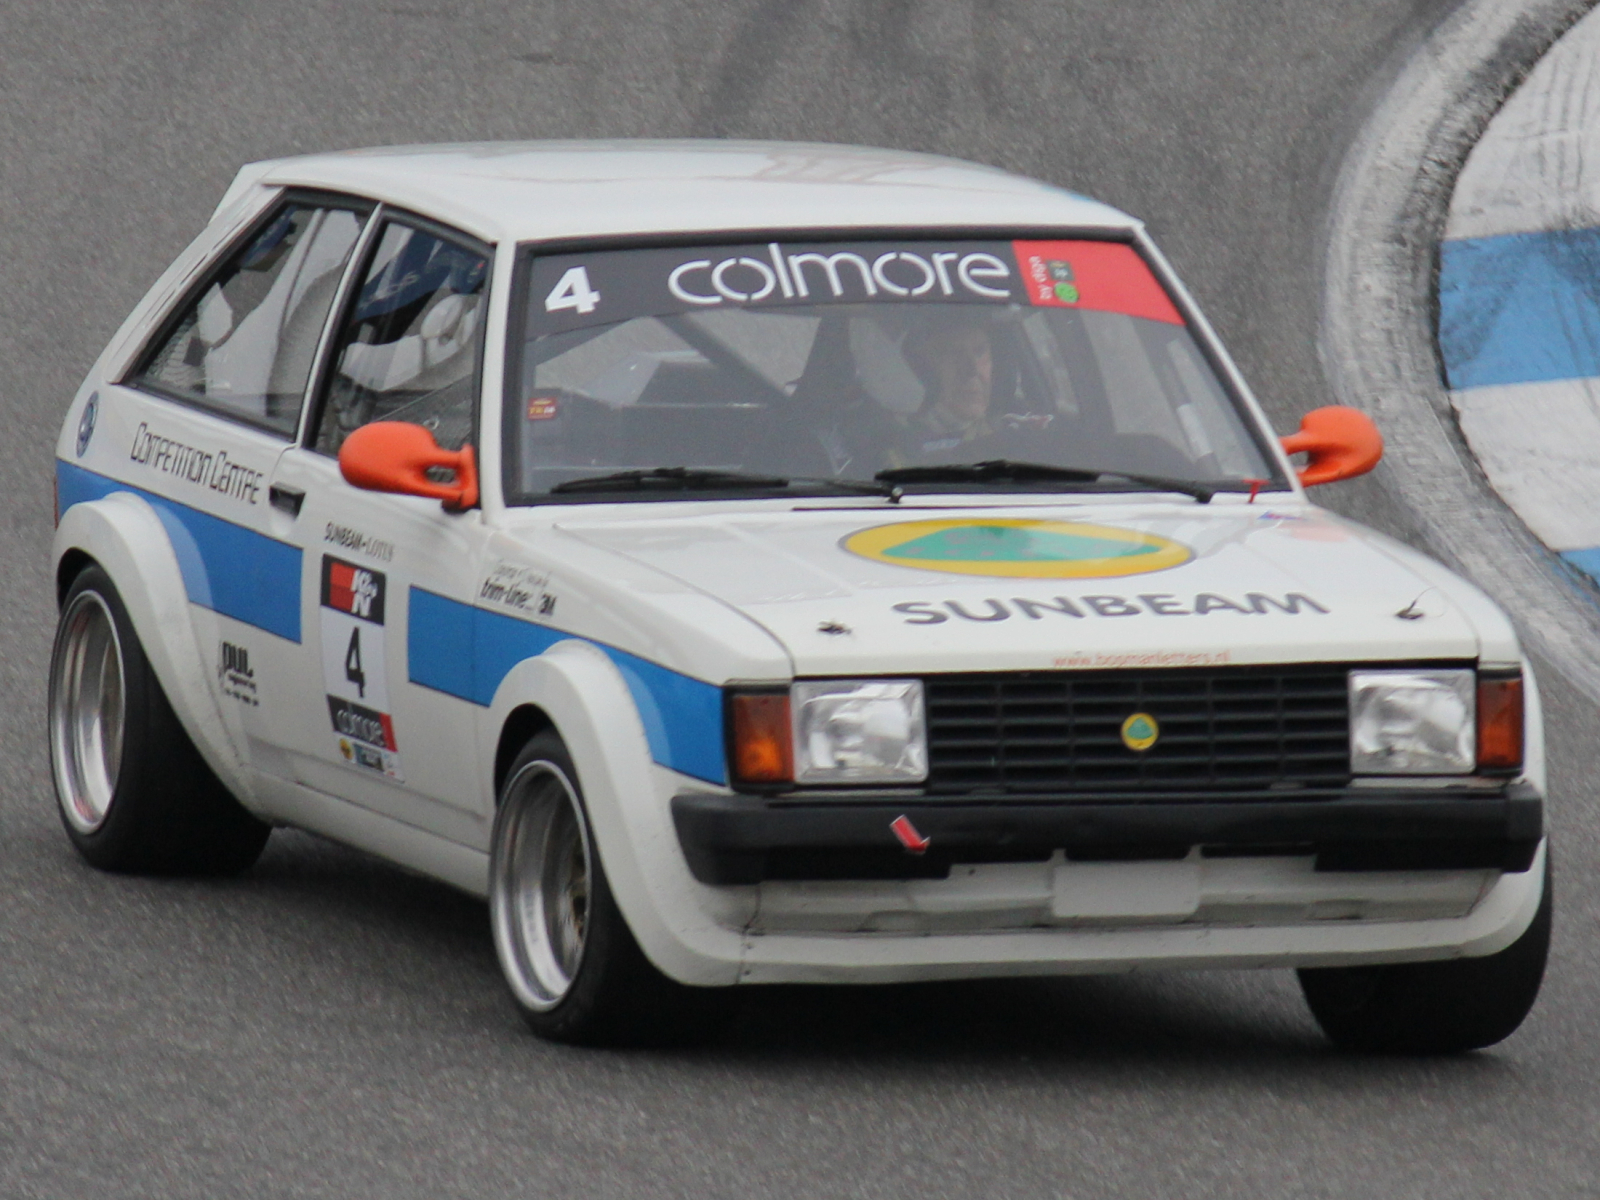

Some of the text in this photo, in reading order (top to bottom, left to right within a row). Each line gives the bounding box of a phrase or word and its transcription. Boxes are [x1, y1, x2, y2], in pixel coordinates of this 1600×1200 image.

[544, 266, 601, 314] 4
[668, 242, 1010, 304] colmore
[893, 592, 1330, 624] SUNBEAM
[345, 626, 366, 699] 4
